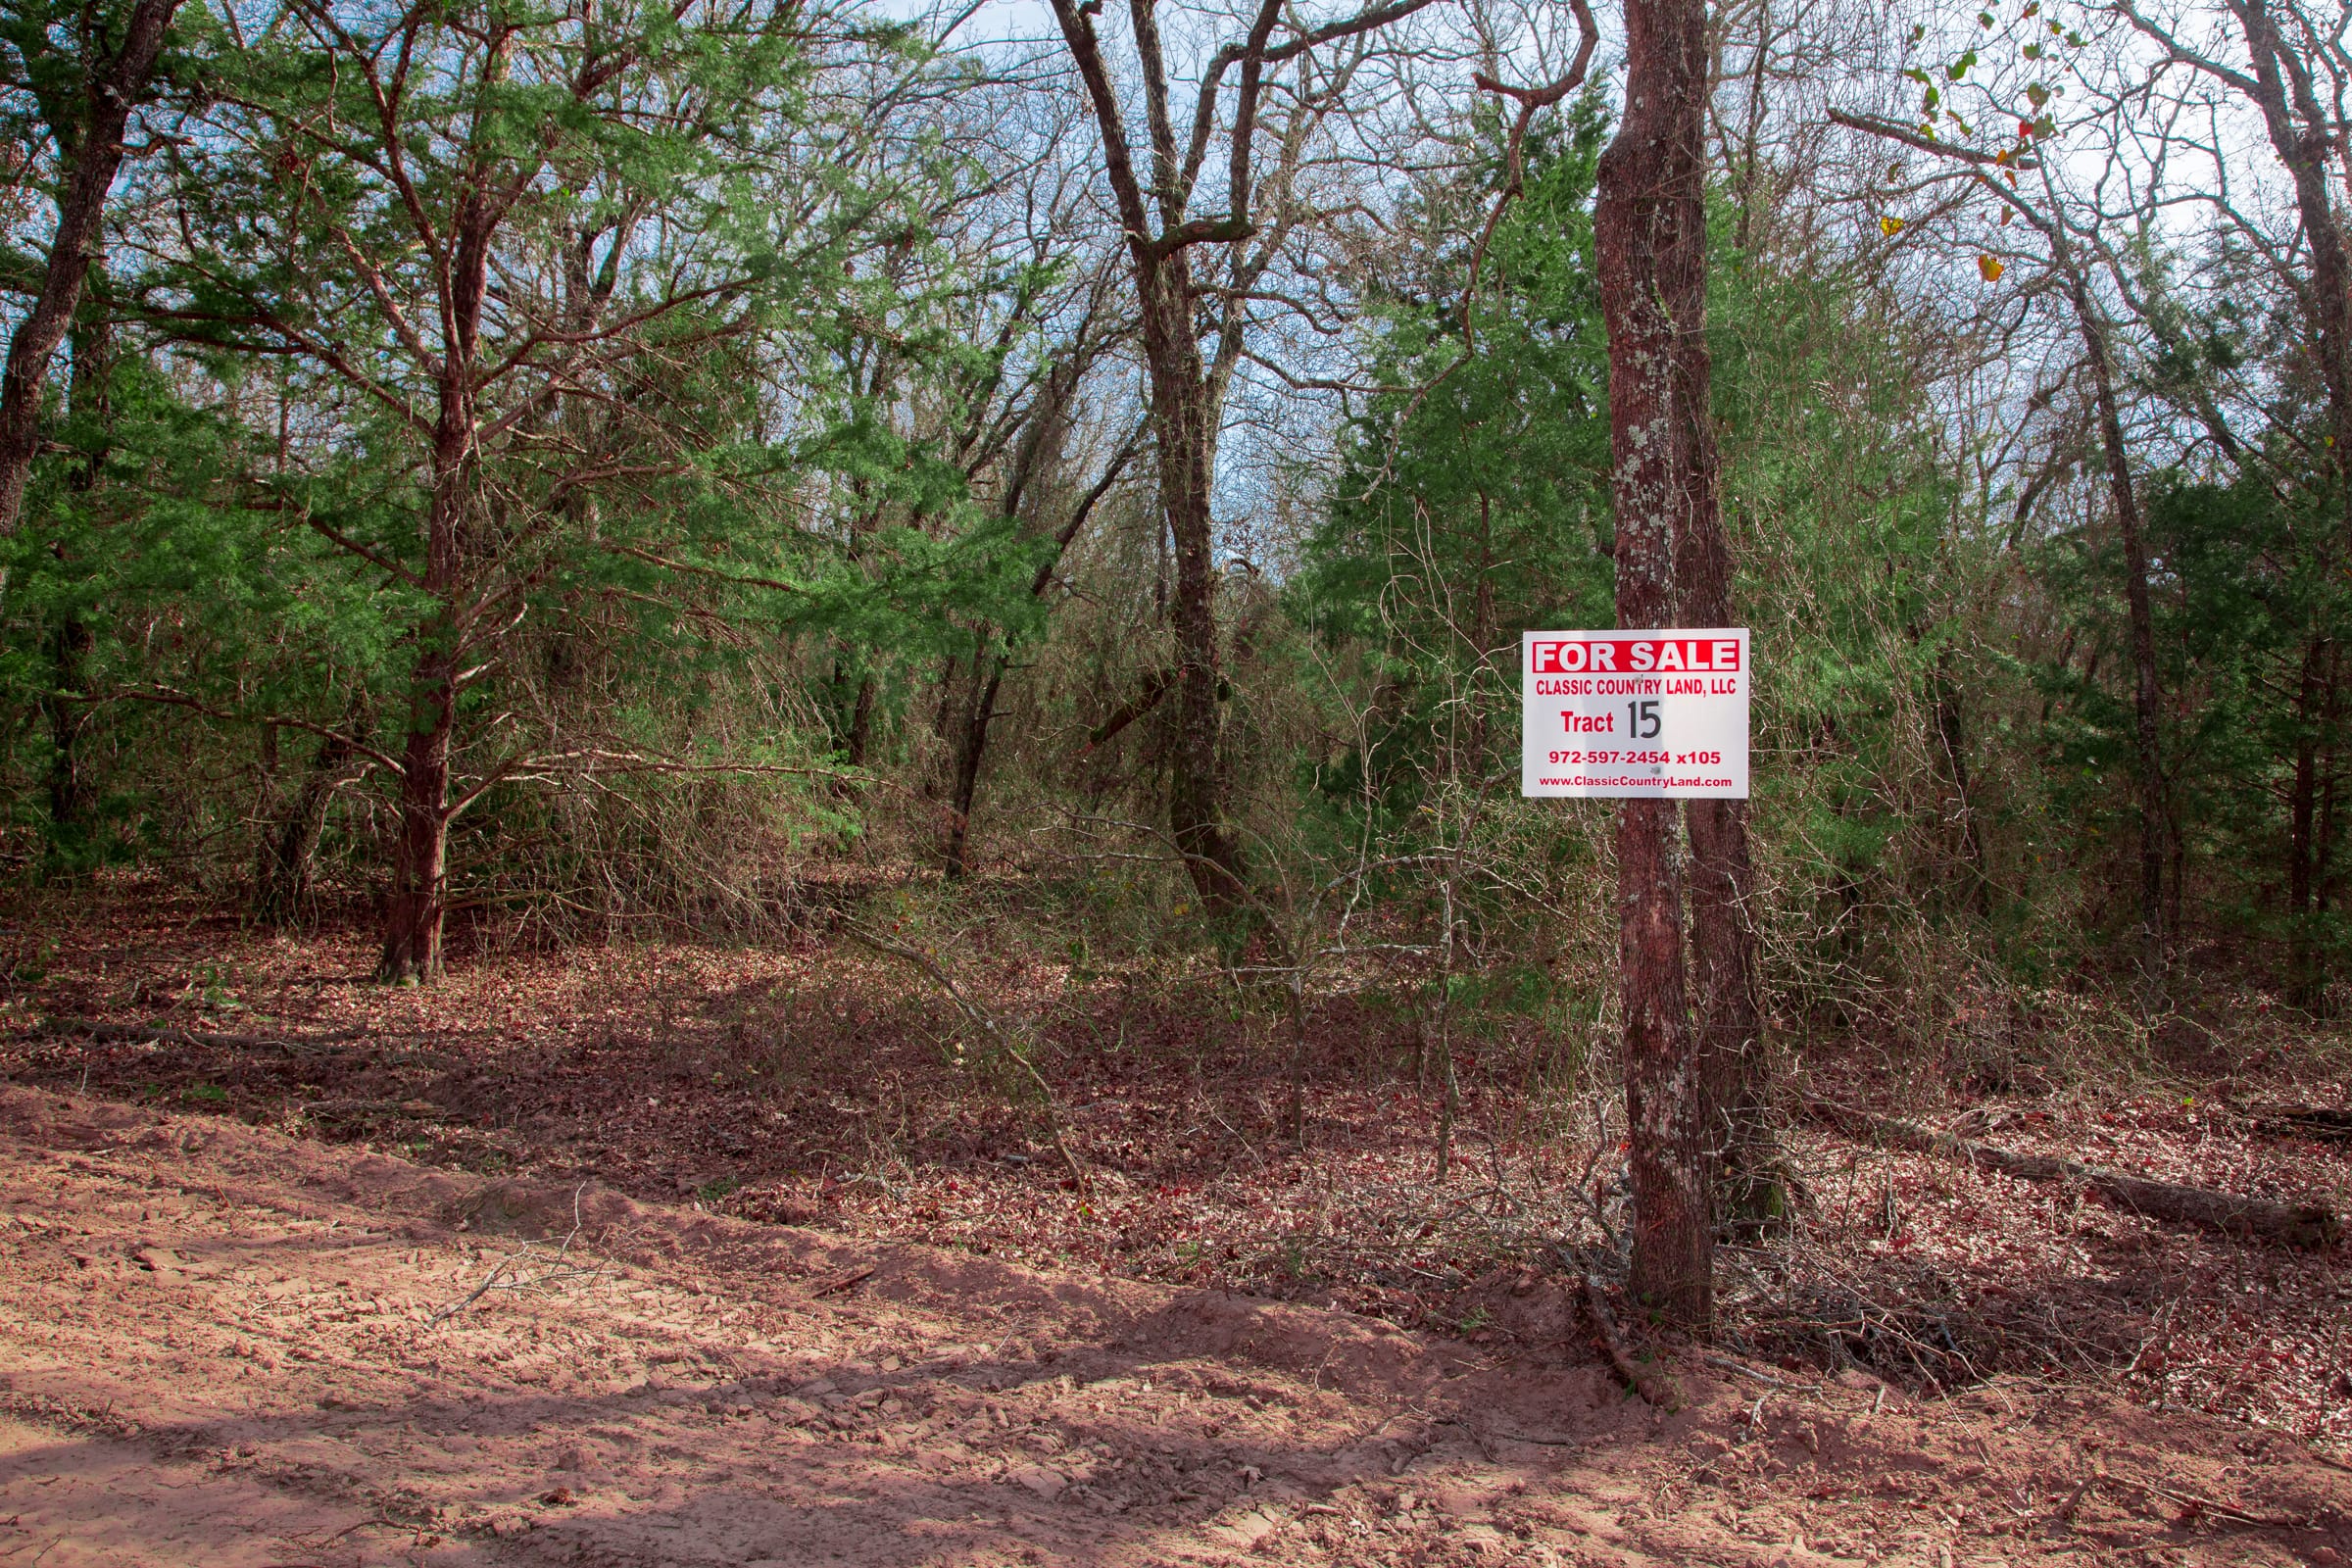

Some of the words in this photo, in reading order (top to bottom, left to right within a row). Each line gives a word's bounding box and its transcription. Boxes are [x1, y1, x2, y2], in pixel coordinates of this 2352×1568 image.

[1535, 643, 1617, 672] FOR
[1630, 641, 1737, 671] SALE
[1536, 679, 1592, 696] CLASSIC
[1597, 678, 1662, 695] COUNTRY
[1666, 678, 1707, 698] LAND,
[1711, 678, 1737, 695] LLC
[1560, 710, 1614, 733] Tract
[1627, 700, 1662, 739] 15
[1548, 751, 1671, 764] 972-597-2454
[1676, 751, 1721, 764] x105
[1539, 775, 1733, 789] www.ClassicCountryLand.com
